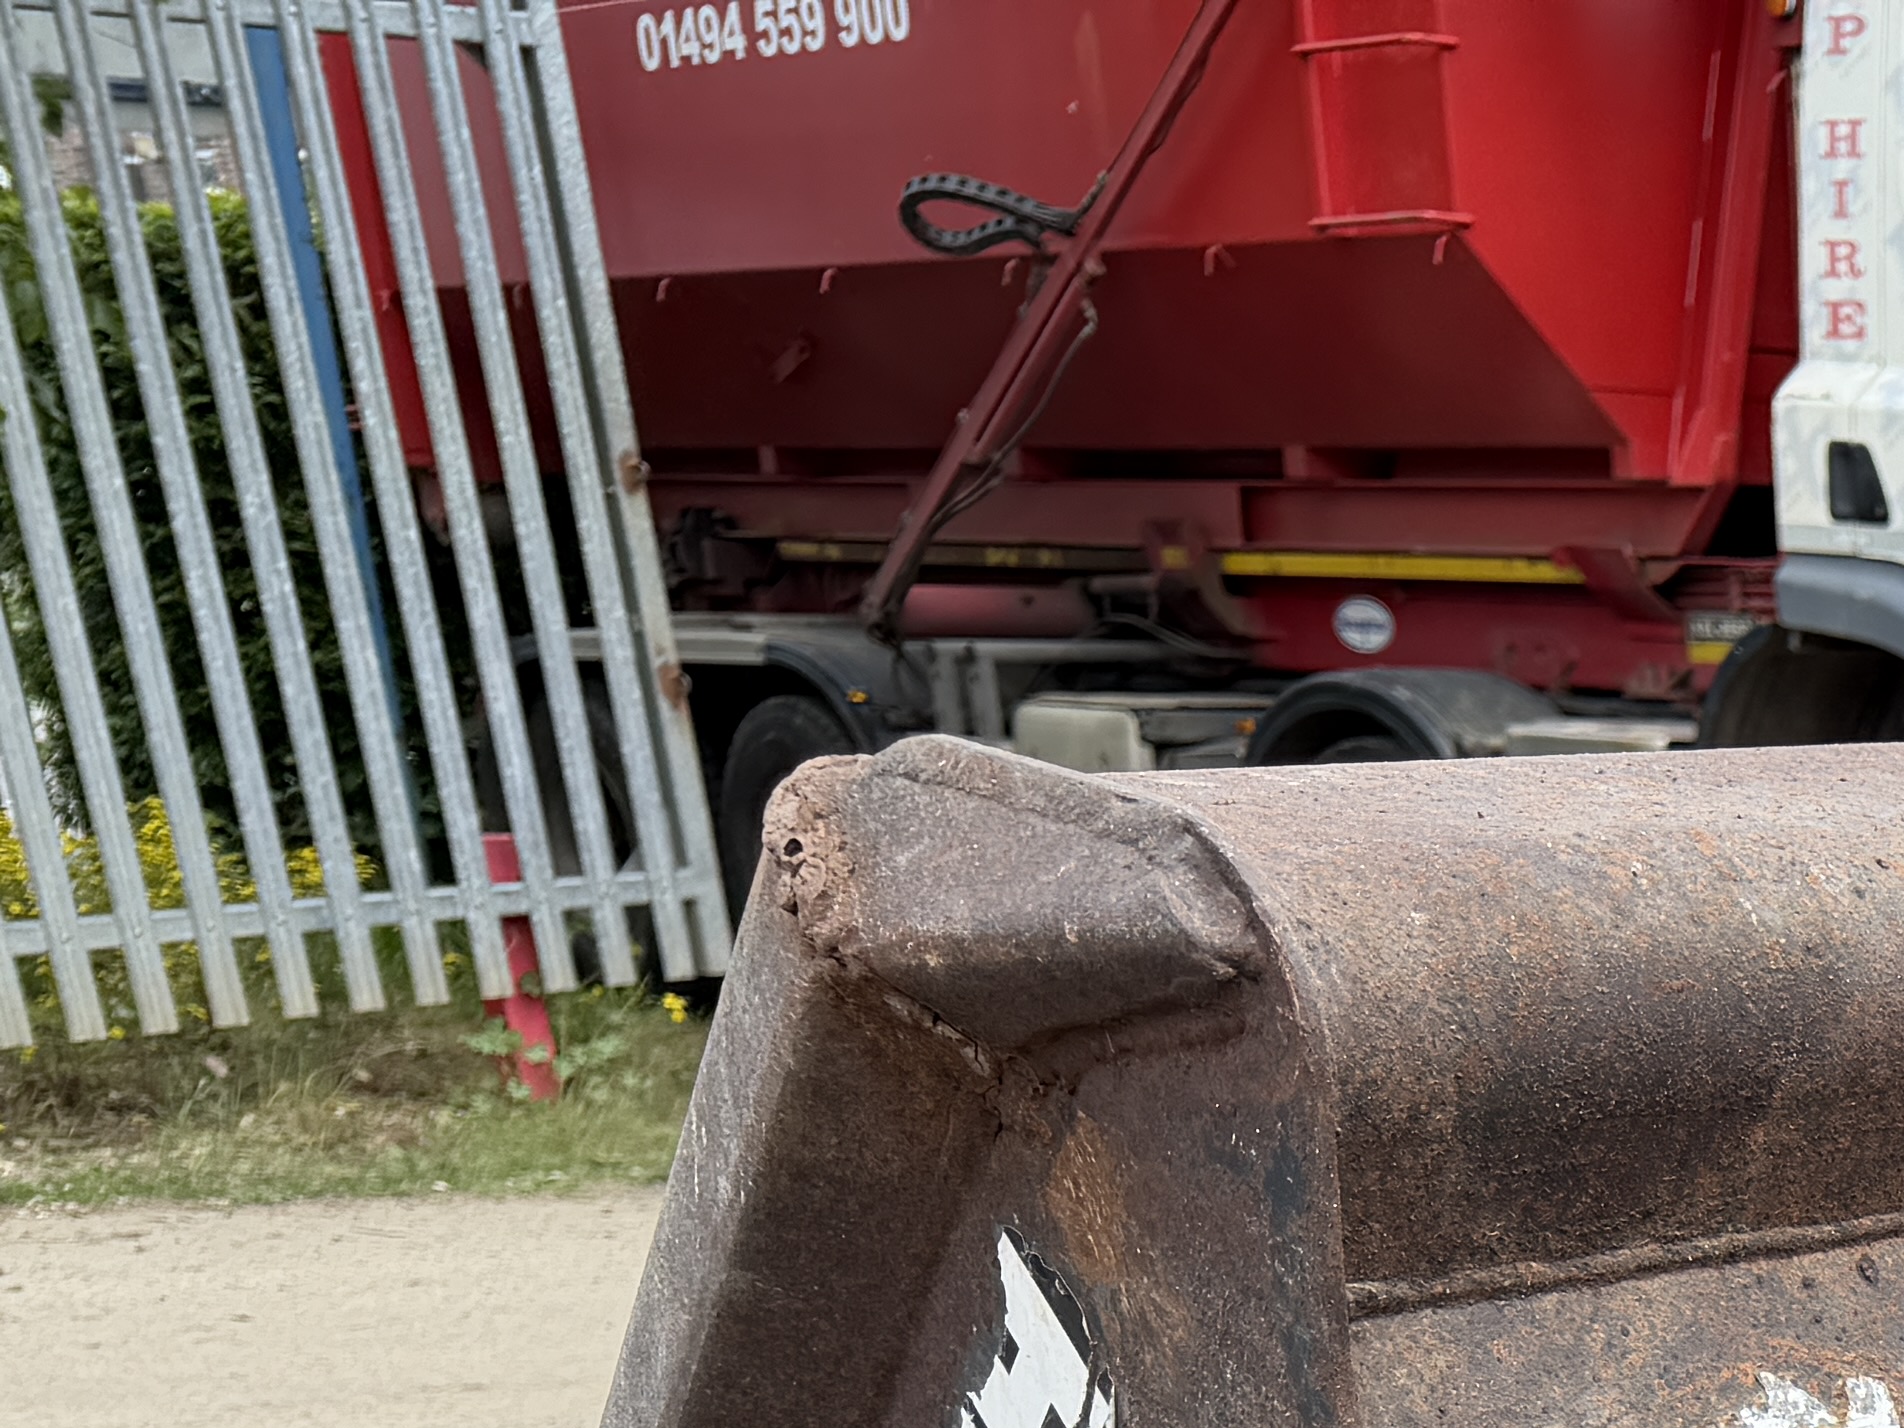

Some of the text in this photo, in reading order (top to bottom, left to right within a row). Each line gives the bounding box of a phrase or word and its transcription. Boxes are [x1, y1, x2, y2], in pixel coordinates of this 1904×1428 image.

[636, 0, 911, 71] 01494 559 900
[1819, 118, 1868, 341] HIRE
